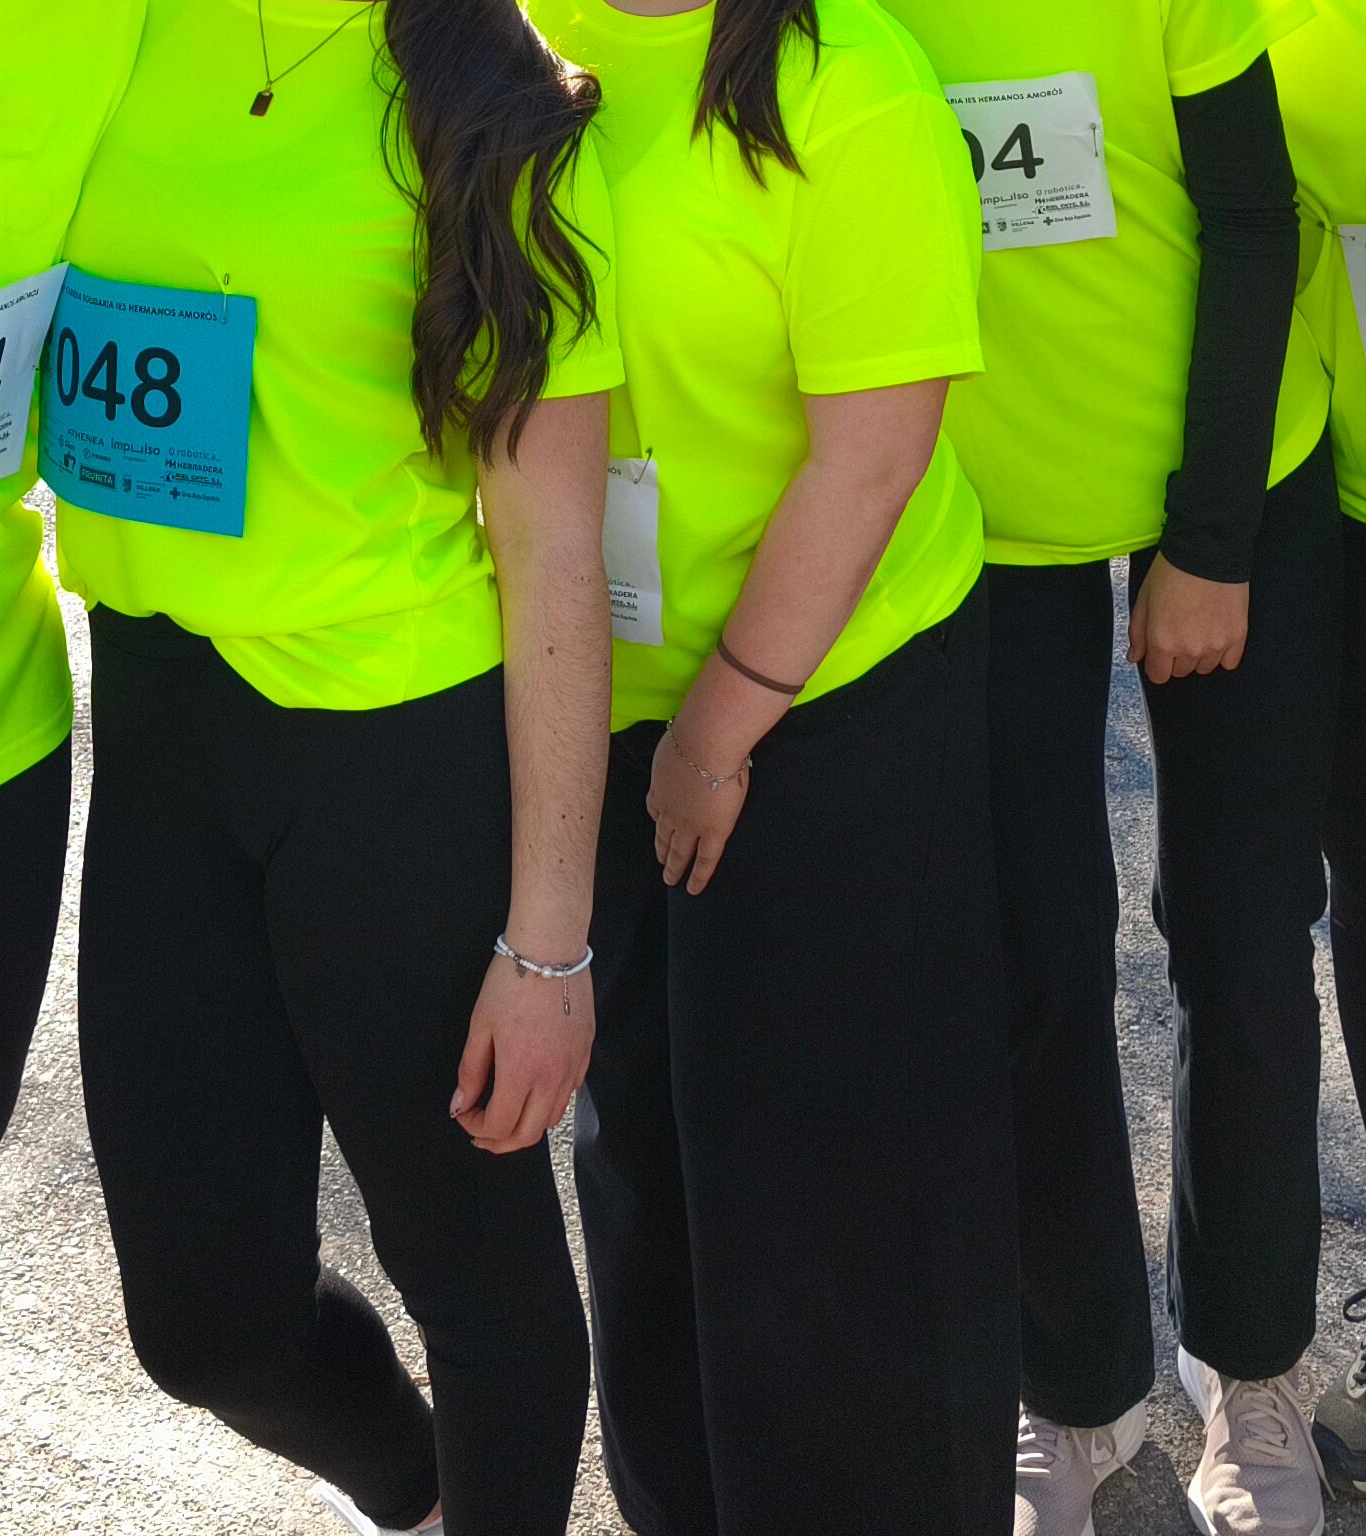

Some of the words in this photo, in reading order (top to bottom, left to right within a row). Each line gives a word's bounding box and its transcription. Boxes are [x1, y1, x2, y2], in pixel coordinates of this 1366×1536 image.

[965, 96, 976, 104] IES
[978, 93, 1024, 104] HERMANOS
[1026, 88, 1063, 99] AMORÓS
[115, 302, 126, 312] IES
[129, 304, 176, 317] HERMANOS
[178, 310, 218, 322] AMORÓS
[56, 326, 182, 428] 048
[110, 437, 161, 456] impulso
